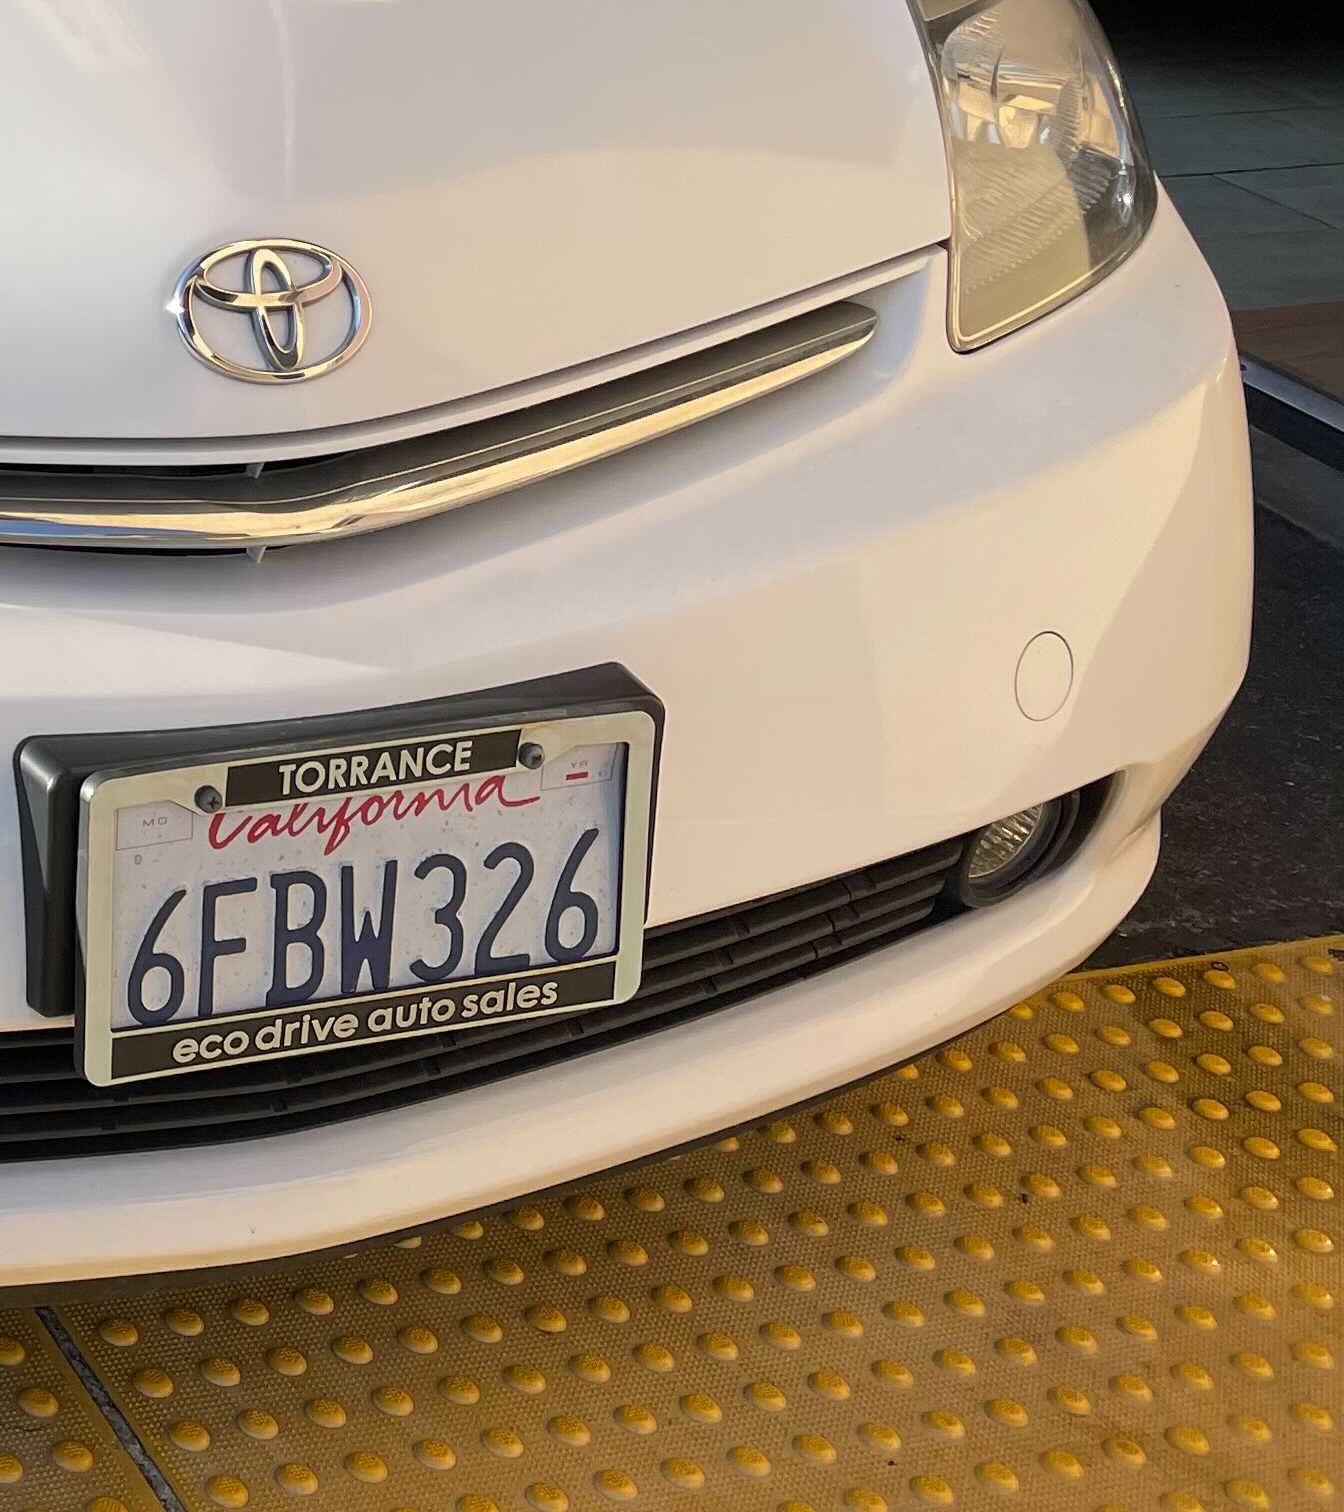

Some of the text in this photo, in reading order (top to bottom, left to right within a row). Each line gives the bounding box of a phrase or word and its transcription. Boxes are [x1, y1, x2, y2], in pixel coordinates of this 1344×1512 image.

[279, 741, 473, 795] TORRANCE
[142, 816, 168, 827] MO
[208, 776, 540, 856] California
[127, 827, 599, 1026] 6FBW326
[172, 979, 559, 1064] eco drive auto sales
